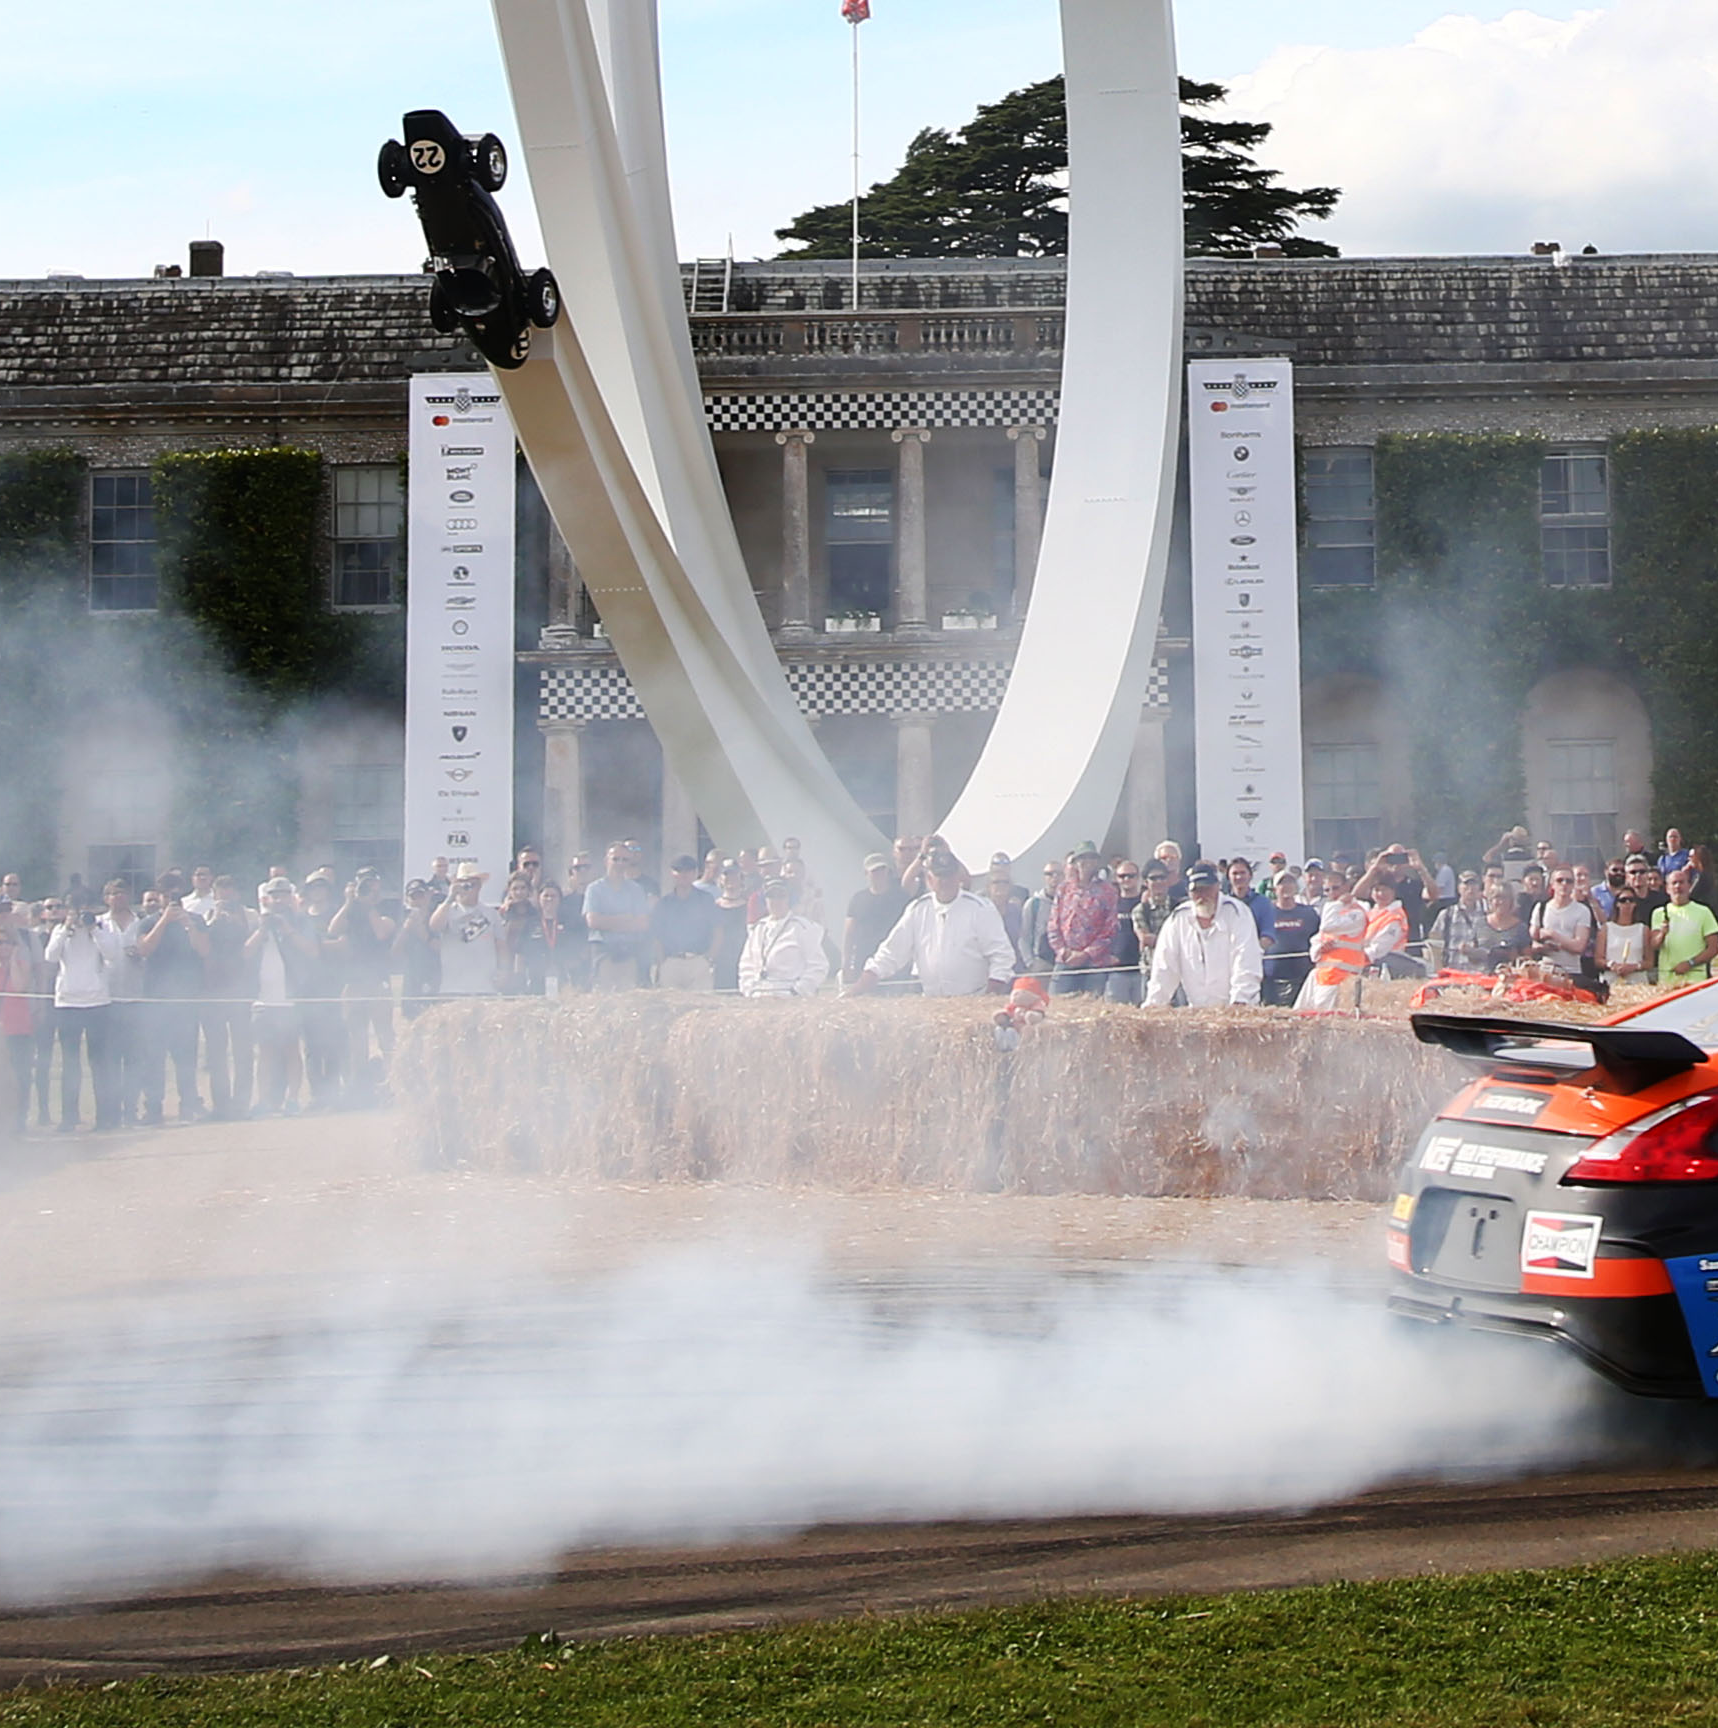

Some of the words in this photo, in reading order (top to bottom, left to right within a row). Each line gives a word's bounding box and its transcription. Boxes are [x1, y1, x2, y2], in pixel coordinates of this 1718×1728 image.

[413, 145, 442, 169] 22
[448, 834, 469, 845] FIA
[1530, 1233, 1587, 1255] CHAMPION
